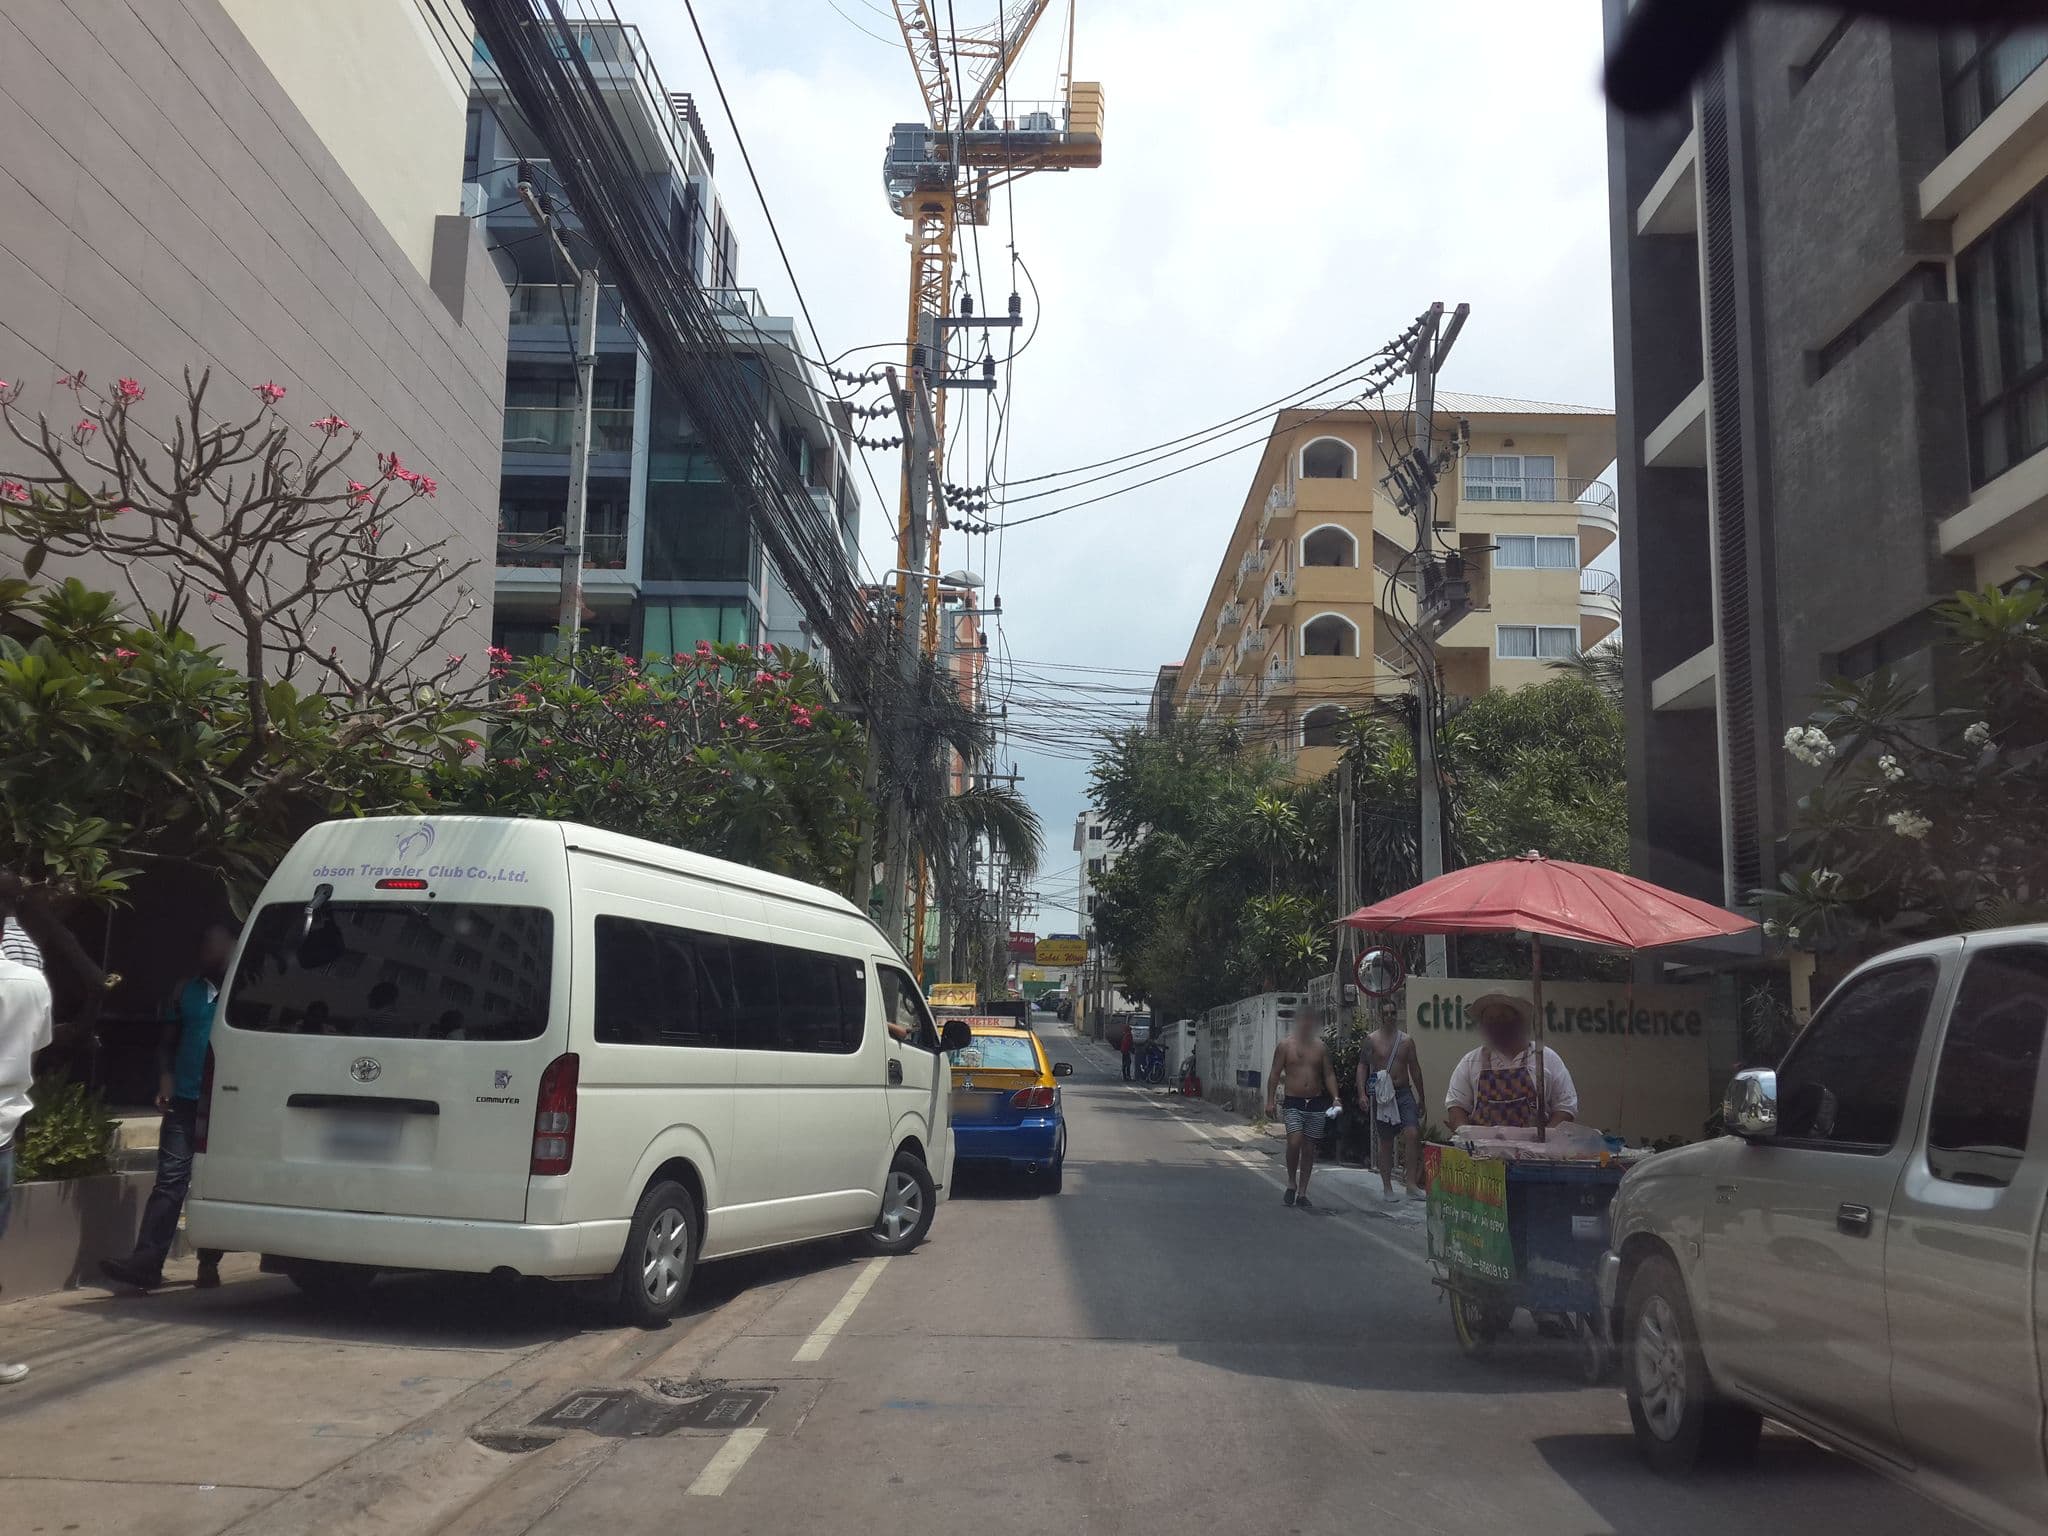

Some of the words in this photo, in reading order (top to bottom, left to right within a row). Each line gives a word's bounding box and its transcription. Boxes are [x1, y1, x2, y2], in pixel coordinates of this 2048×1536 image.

[360, 864, 423, 878] Traveler
[428, 865, 464, 879] Club
[476, 1096, 520, 1105] COMMUTER
